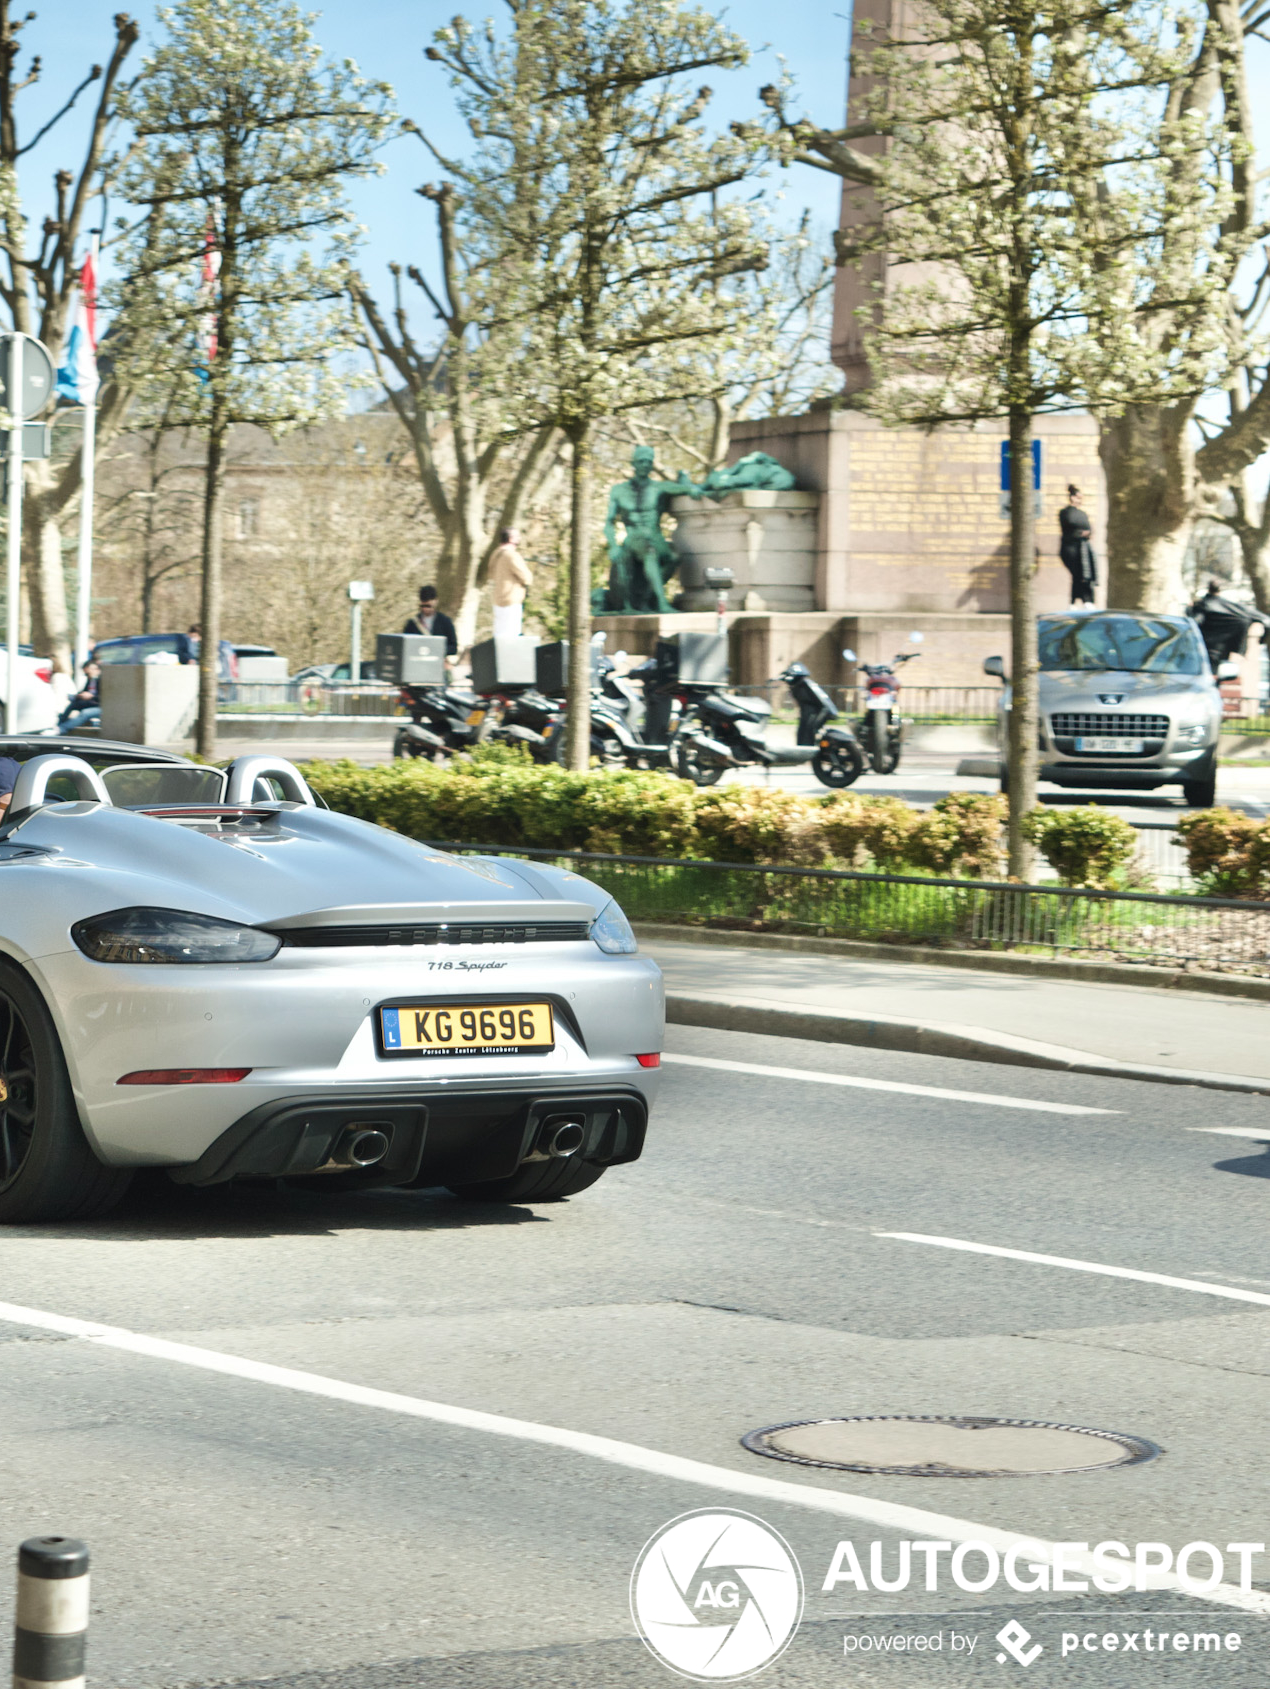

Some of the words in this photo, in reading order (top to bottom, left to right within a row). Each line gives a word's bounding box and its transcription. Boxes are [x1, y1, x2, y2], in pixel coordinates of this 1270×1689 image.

[388, 928, 536, 939] PORSCHE
[428, 962, 453, 970] 718
[455, 961, 508, 972] Spyder
[389, 1031, 397, 1043] L
